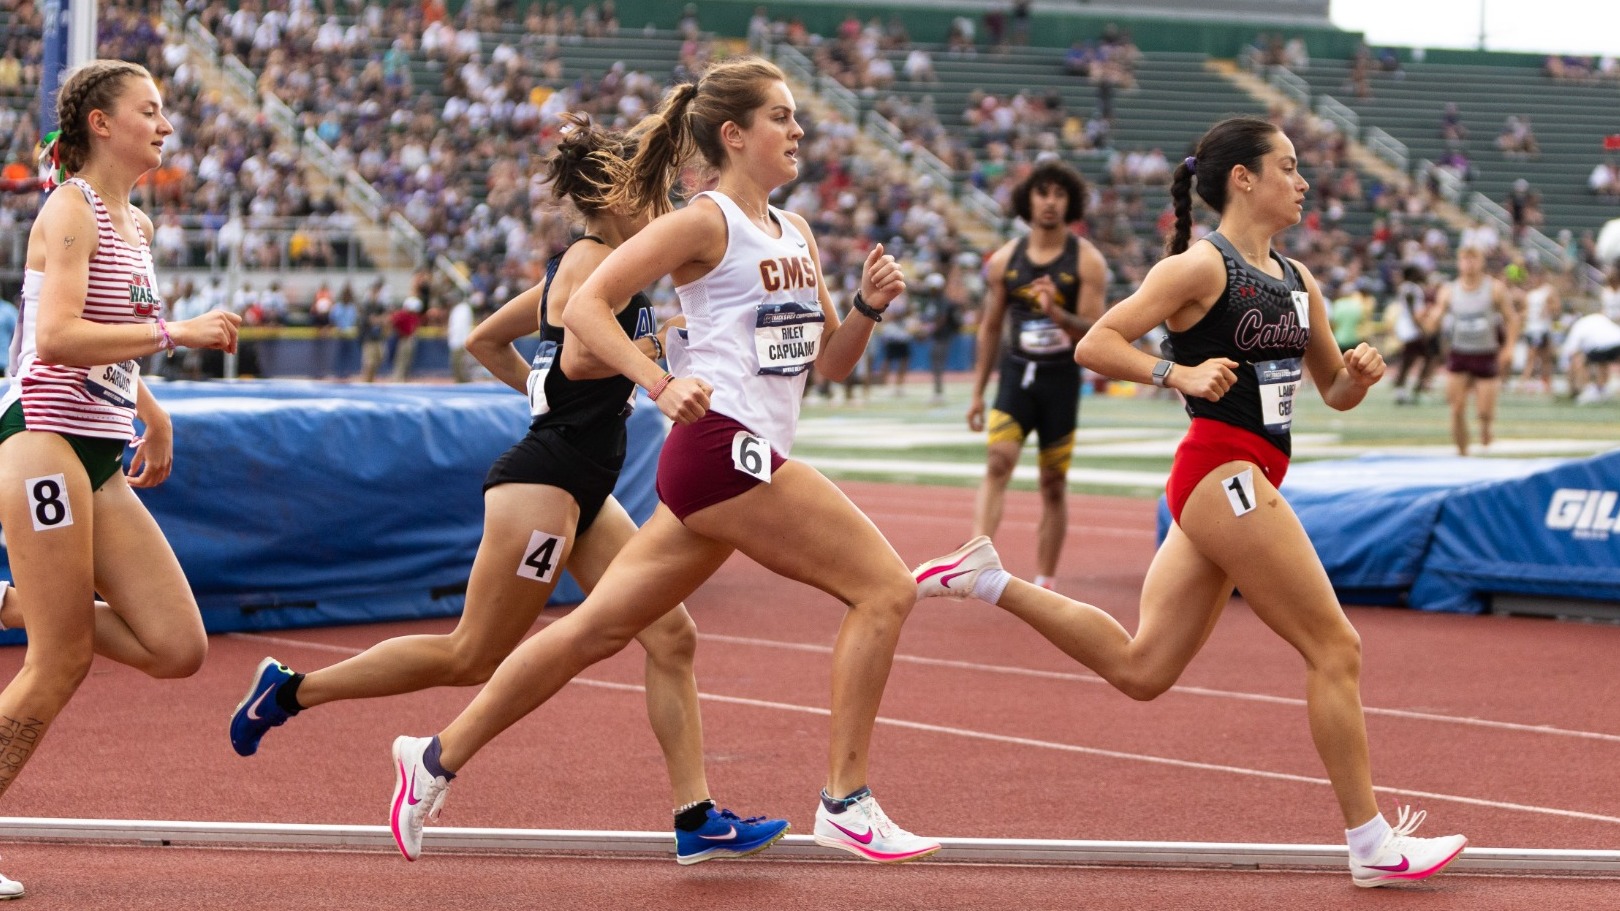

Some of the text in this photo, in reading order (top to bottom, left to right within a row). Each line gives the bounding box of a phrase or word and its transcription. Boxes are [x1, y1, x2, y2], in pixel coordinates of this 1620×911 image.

[759, 256, 817, 293] CMS
[769, 341, 815, 360] CAPUANO
[781, 326, 804, 340] RILEY
[738, 436, 763, 474] 6
[32, 479, 66, 526] 8
[1228, 477, 1252, 511] 1
[524, 537, 558, 578] 4
[16, 717, 44, 748] NOT
